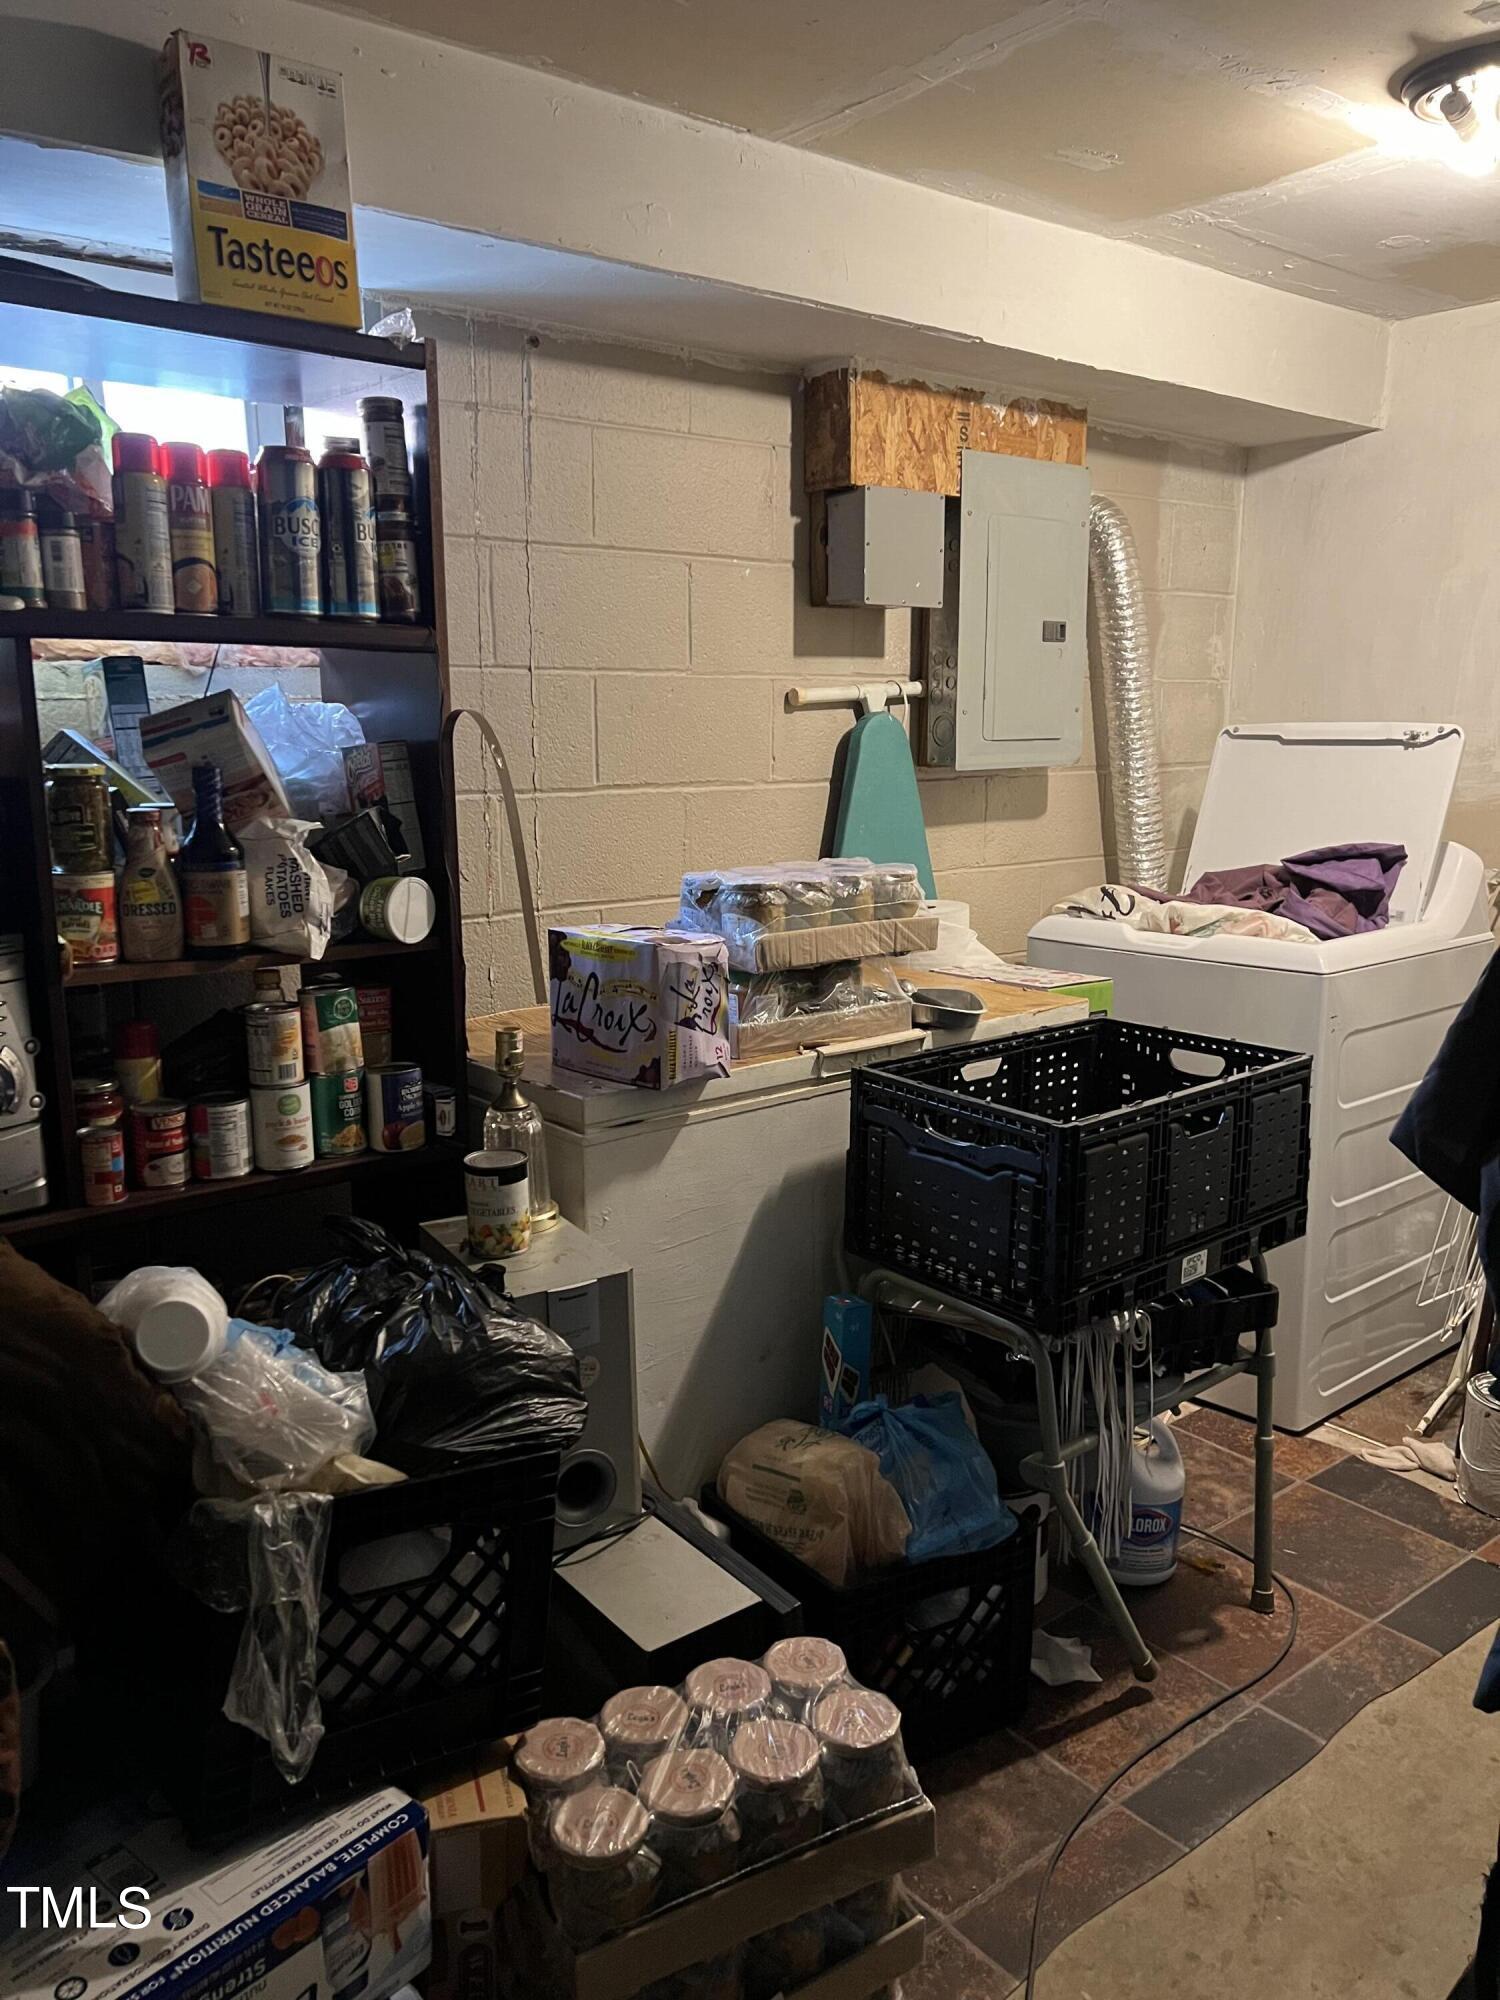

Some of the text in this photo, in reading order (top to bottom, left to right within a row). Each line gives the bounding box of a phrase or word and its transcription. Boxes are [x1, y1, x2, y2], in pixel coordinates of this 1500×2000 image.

[244, 192, 286, 208] WHOLE
[245, 202, 287, 217] GRAIN
[246, 210, 289, 225] CEREAL
[274, 515, 320, 537] BUSC
[291, 536, 319, 549] ICE
[264, 866, 276, 906] FLAKES
[276, 854, 292, 919] POTATOES
[288, 857, 304, 913] MASHED
[123, 902, 177, 917] DRESSED
[1132, 1517, 1167, 1533] LOROX
[332, 1810, 410, 1868] COMPLETE,
[257, 1860, 338, 1919] BALANCED
[95, 1950, 170, 2000] CONSIDERATIO
[140, 1975, 166, 1994] FOR
[198, 1957, 267, 2000] Streng
